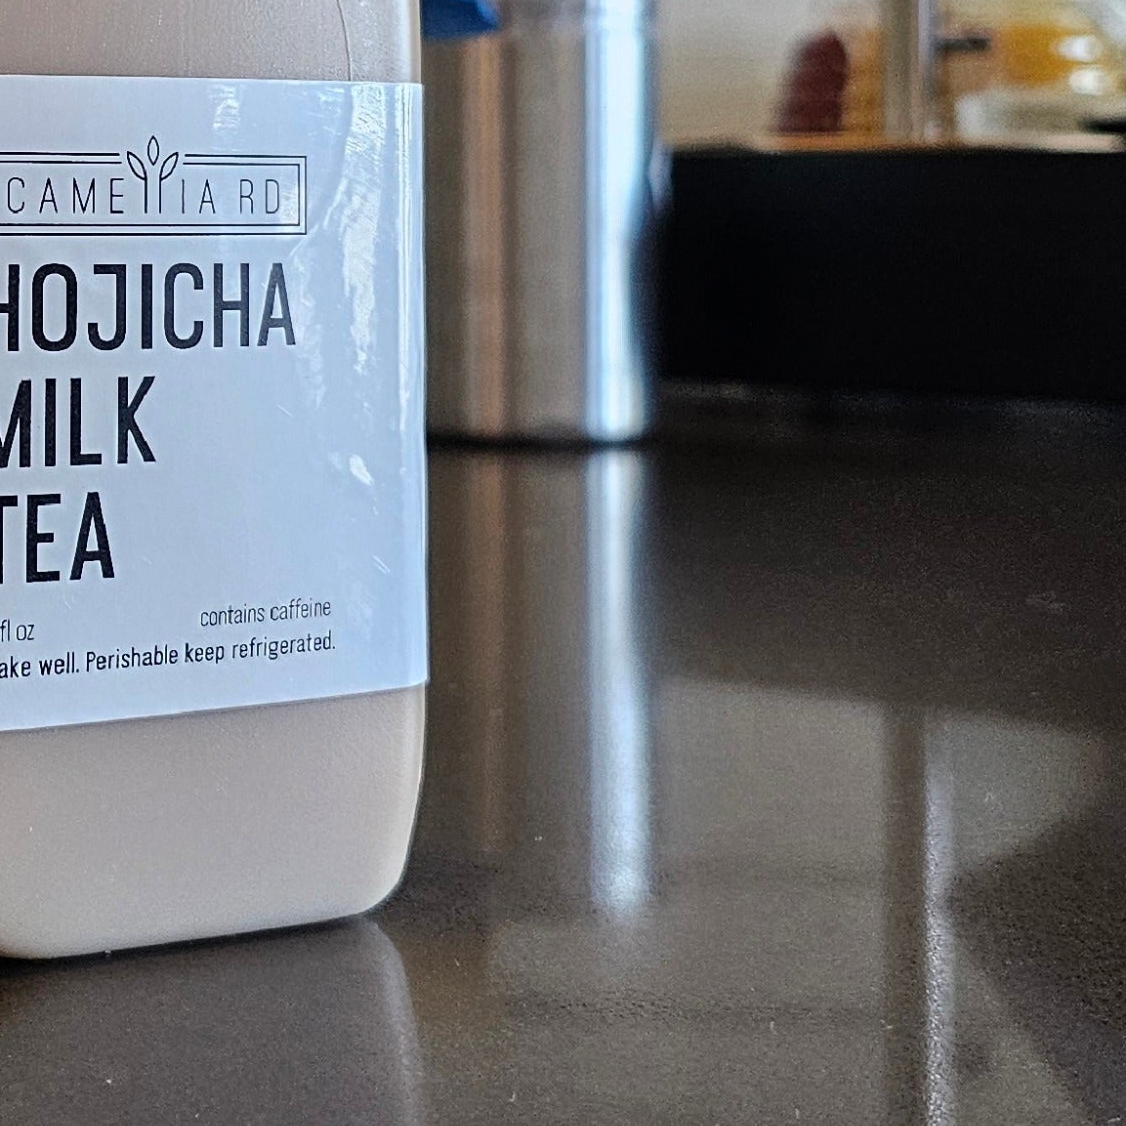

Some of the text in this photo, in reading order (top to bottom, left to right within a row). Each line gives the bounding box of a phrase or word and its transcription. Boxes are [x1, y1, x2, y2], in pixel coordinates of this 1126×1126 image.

[239, 178, 281, 215] RD
[200, 597, 331, 627] contains caffeine
[0, 619, 11, 642] fl
[16, 624, 35, 641] oz
[39, 651, 80, 676] well.
[86, 643, 179, 672] Perishable
[185, 642, 225, 664] keep
[231, 629, 336, 660] refrigerated.
